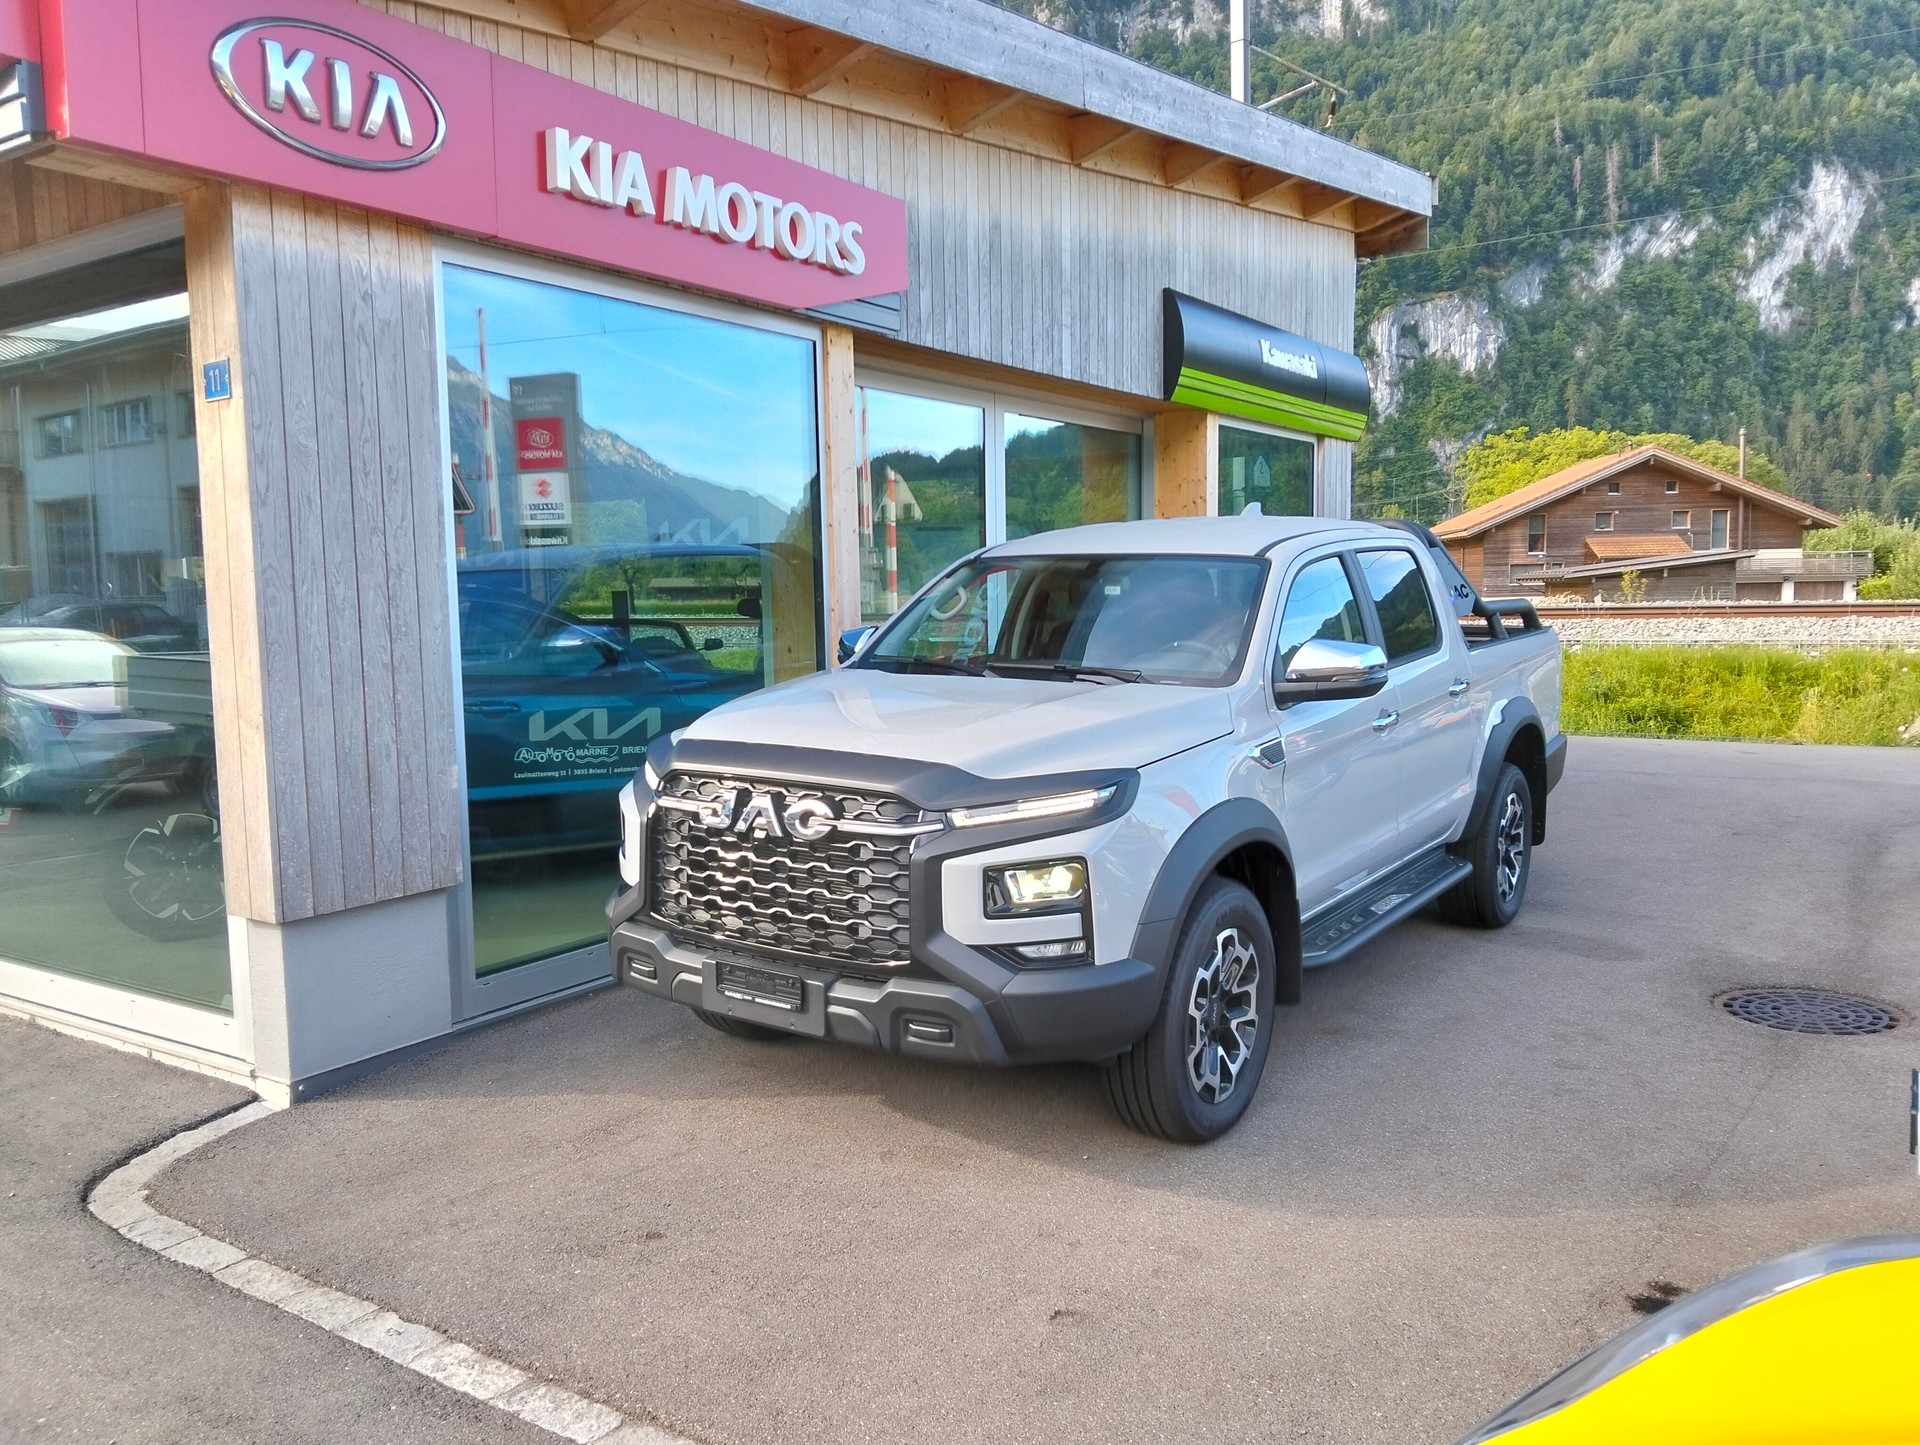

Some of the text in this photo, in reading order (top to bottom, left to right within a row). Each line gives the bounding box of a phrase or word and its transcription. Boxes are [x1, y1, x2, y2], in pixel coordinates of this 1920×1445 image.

[259, 37, 413, 148] KIA
[545, 126, 866, 276] KIA MOTORS
[209, 368, 221, 392] 11
[528, 707, 662, 742] KIA
[576, 747, 609, 757] MARINE
[622, 746, 647, 754] BRIEN
[699, 788, 835, 841] JAC
